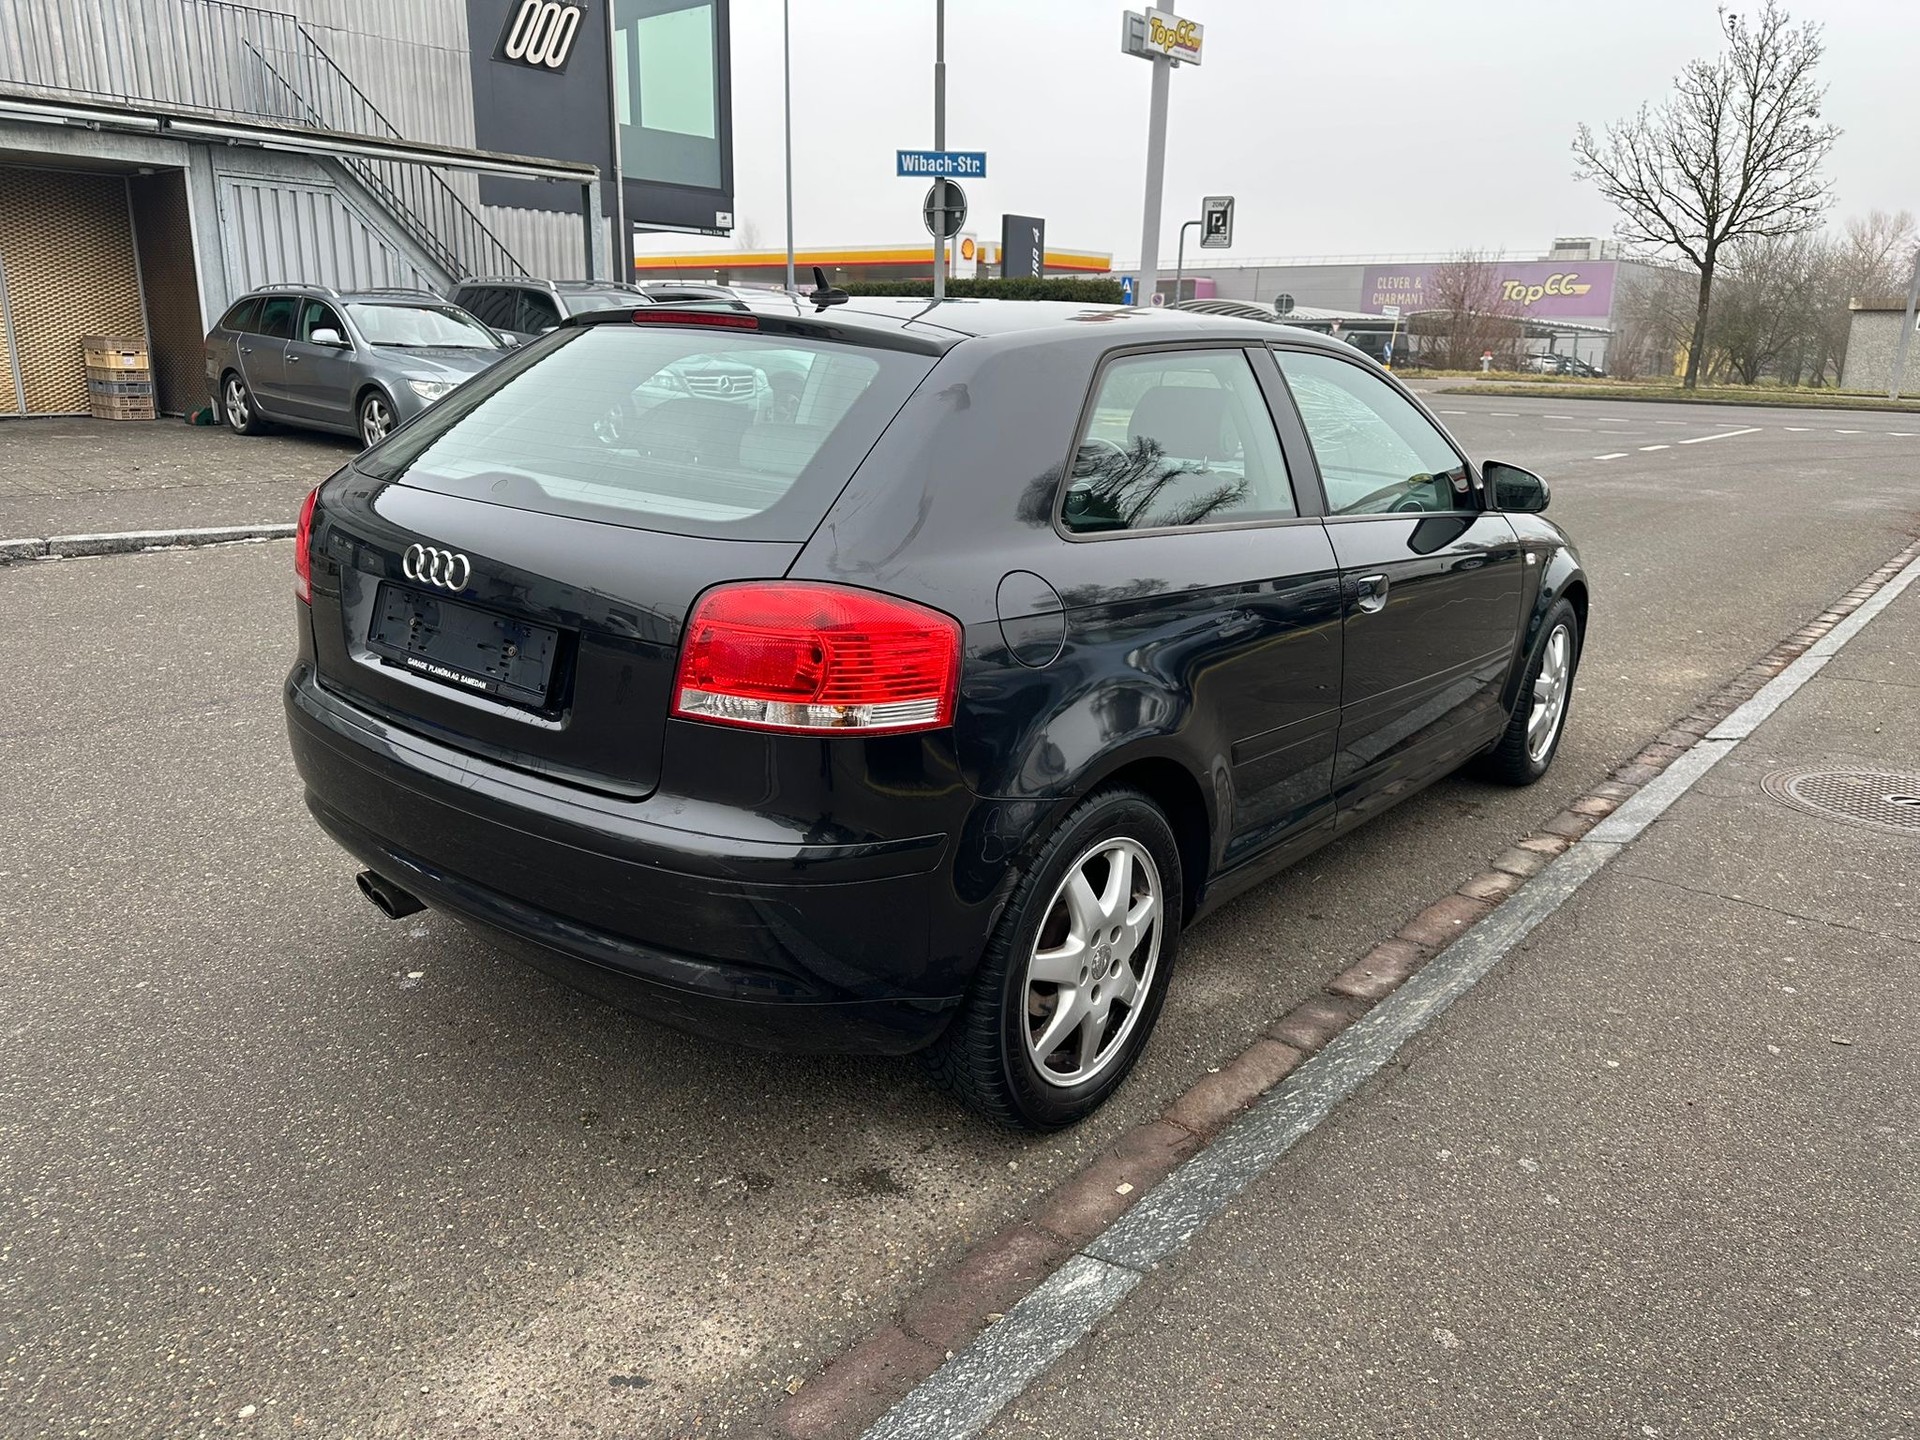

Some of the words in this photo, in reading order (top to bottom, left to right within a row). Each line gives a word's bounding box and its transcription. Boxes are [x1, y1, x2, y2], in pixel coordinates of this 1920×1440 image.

[1150, 17, 1199, 54] TopCC
[901, 154, 980, 173] Wibach-Str.
[1377, 276, 1410, 289] CLEVER
[1414, 276, 1422, 289] &
[1502, 273, 1582, 306] TopCC
[1372, 292, 1425, 305] CHARMANT
[408, 658, 427, 669] GARAGE
[450, 672, 460, 681] AG
[460, 675, 486, 689] SAMEDAN
